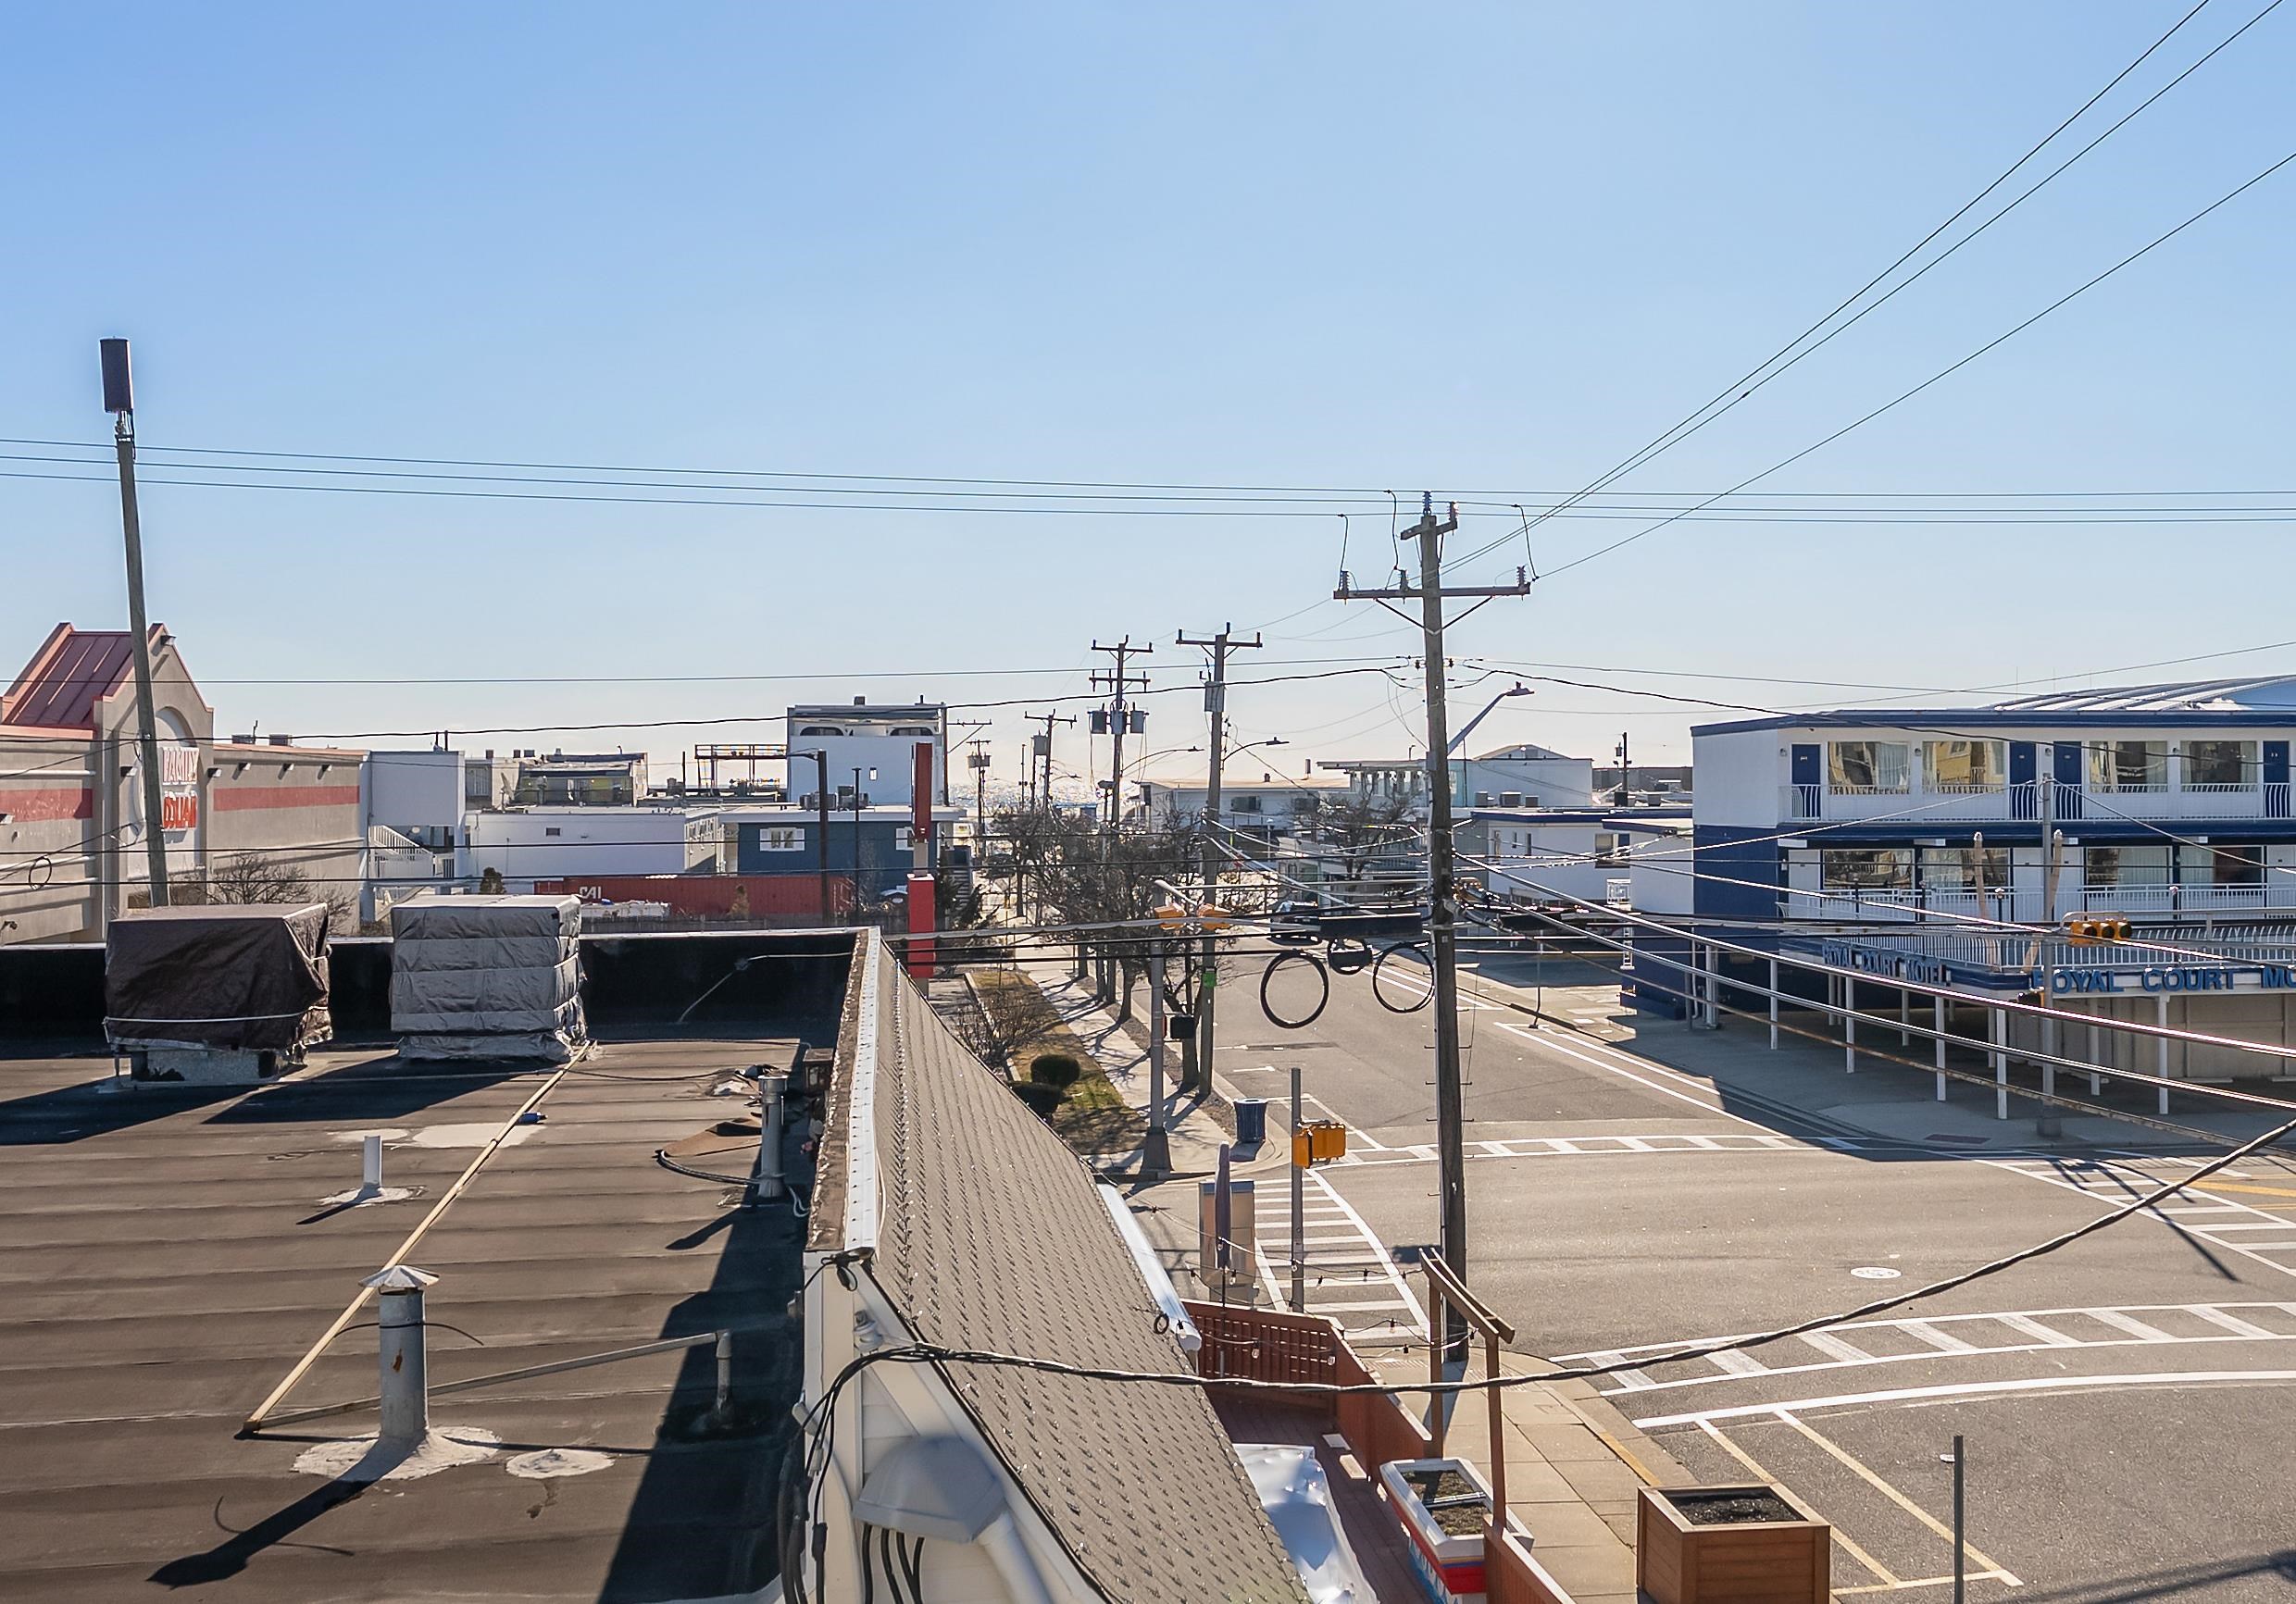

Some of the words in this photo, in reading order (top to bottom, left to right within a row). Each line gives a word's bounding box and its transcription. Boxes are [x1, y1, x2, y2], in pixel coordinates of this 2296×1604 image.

[1822, 942, 1855, 969] ROYAL
[1861, 950, 1901, 977] COURT
[1903, 958, 1949, 987] MOTEL
[2141, 967, 2236, 992] COURT
